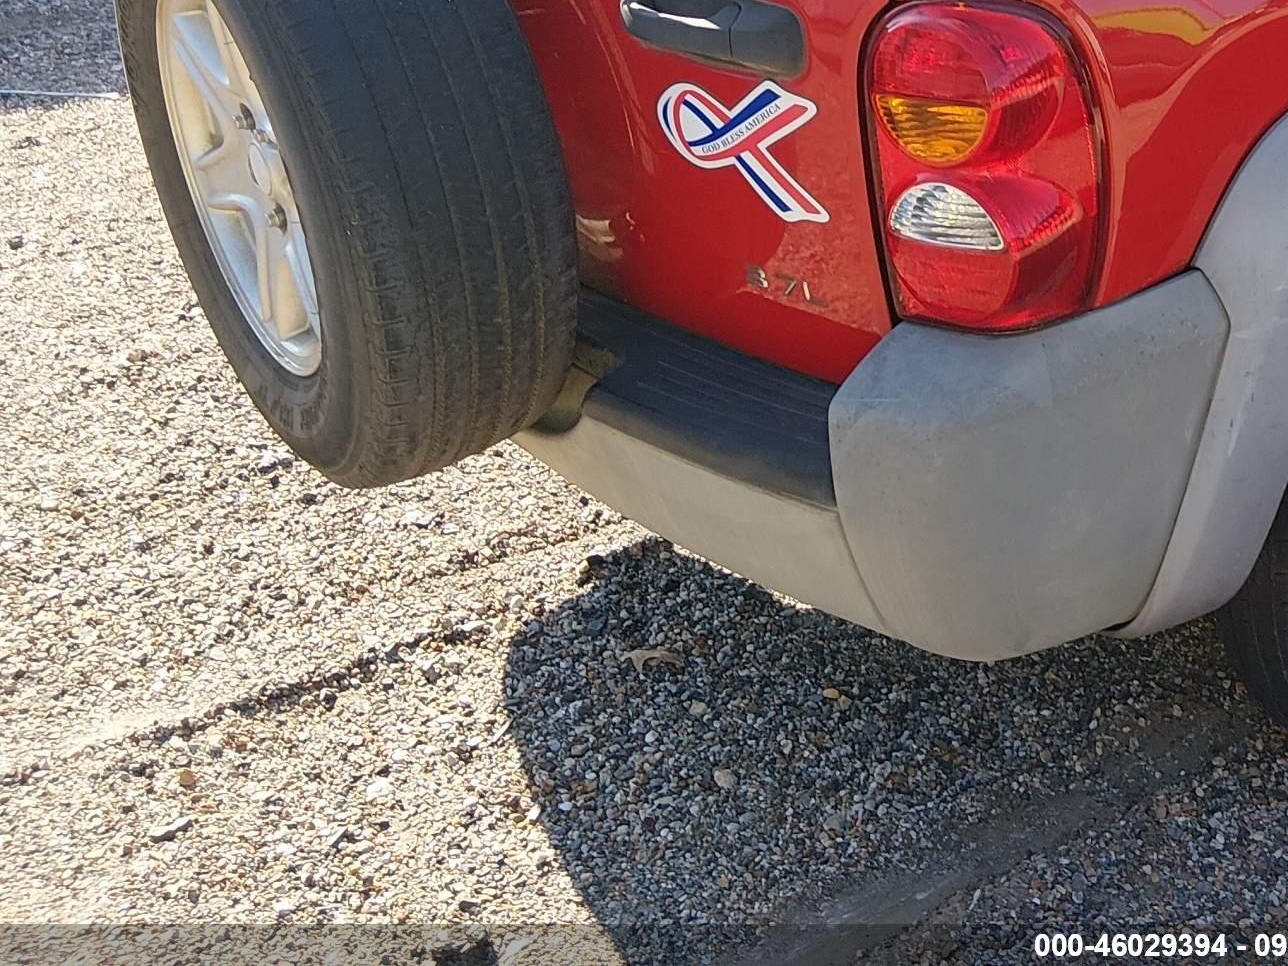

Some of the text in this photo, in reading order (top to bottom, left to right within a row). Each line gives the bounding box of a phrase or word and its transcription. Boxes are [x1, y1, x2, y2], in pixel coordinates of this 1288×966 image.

[701, 103, 782, 154] GOD BLESS AMERICA
[746, 265, 829, 307] 37L
